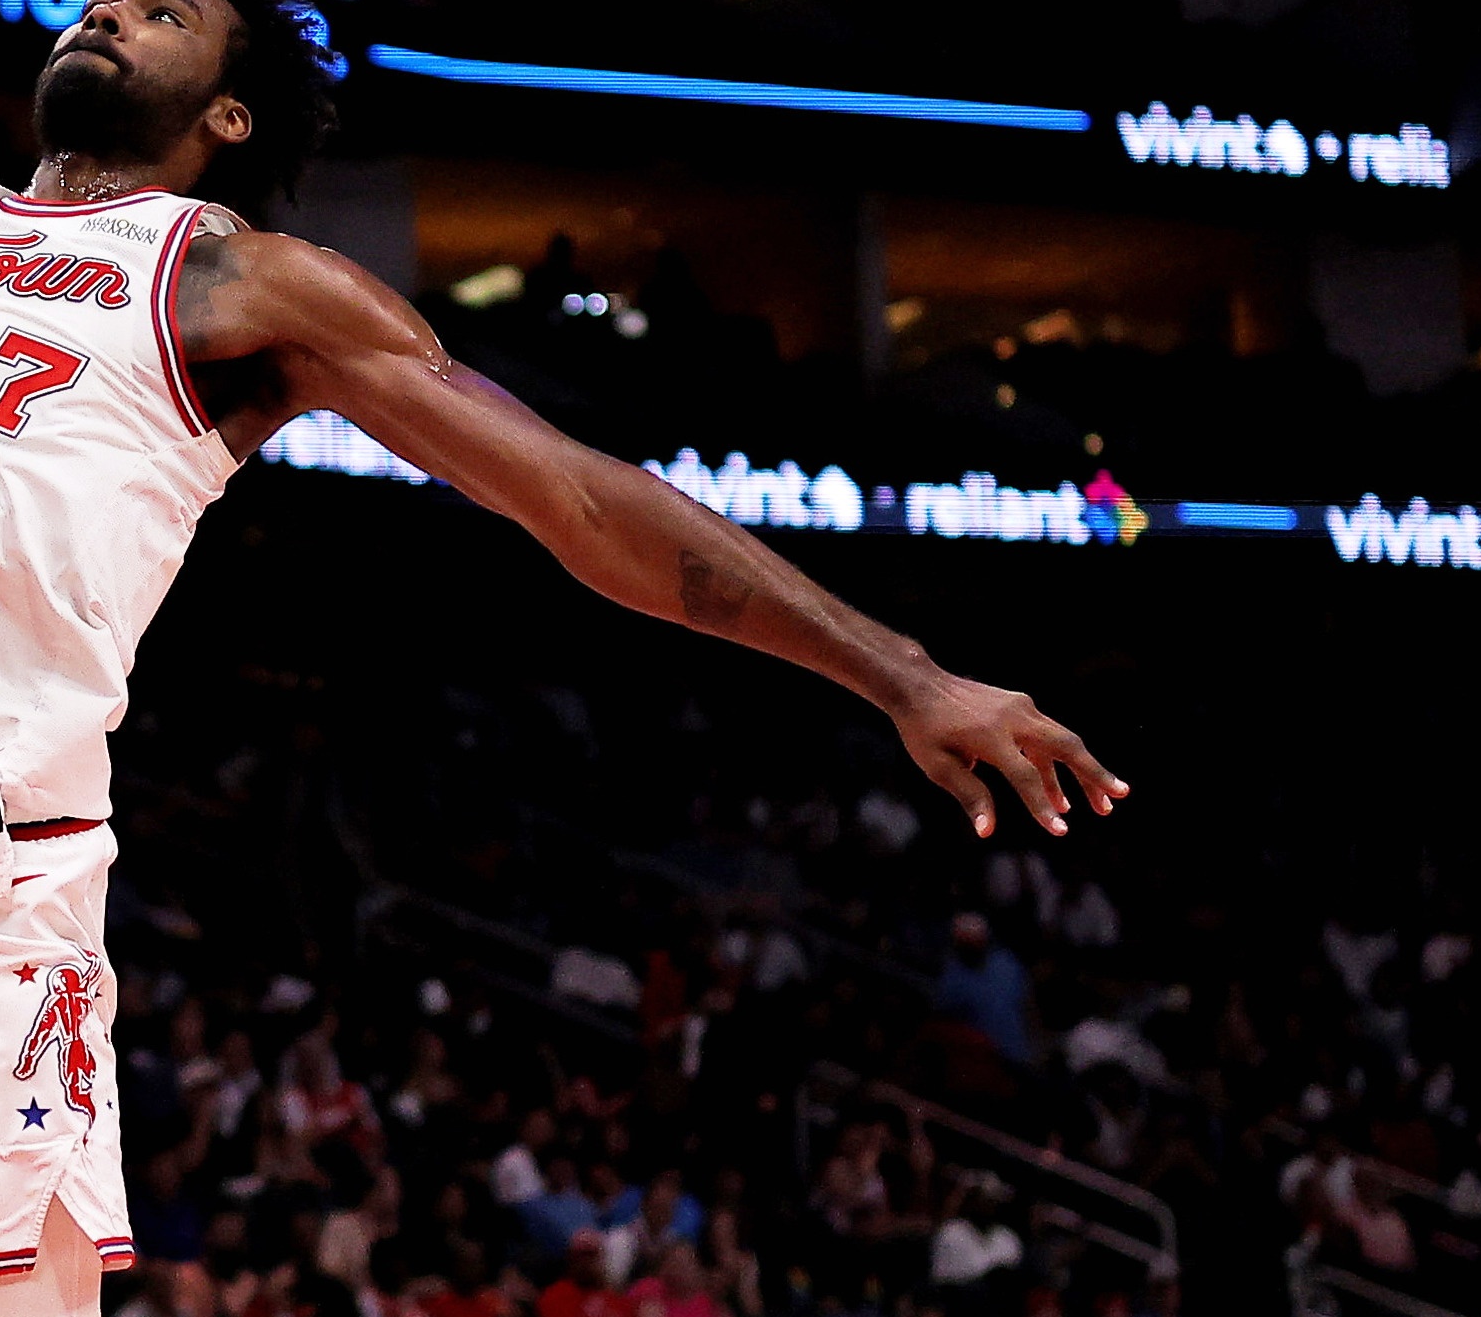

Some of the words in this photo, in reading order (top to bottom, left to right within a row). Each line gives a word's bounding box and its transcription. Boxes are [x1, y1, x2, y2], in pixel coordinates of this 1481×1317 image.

[1117, 102, 1261, 173] vivint
[905, 472, 1093, 545] reliant
[1326, 494, 1479, 569] vivint
